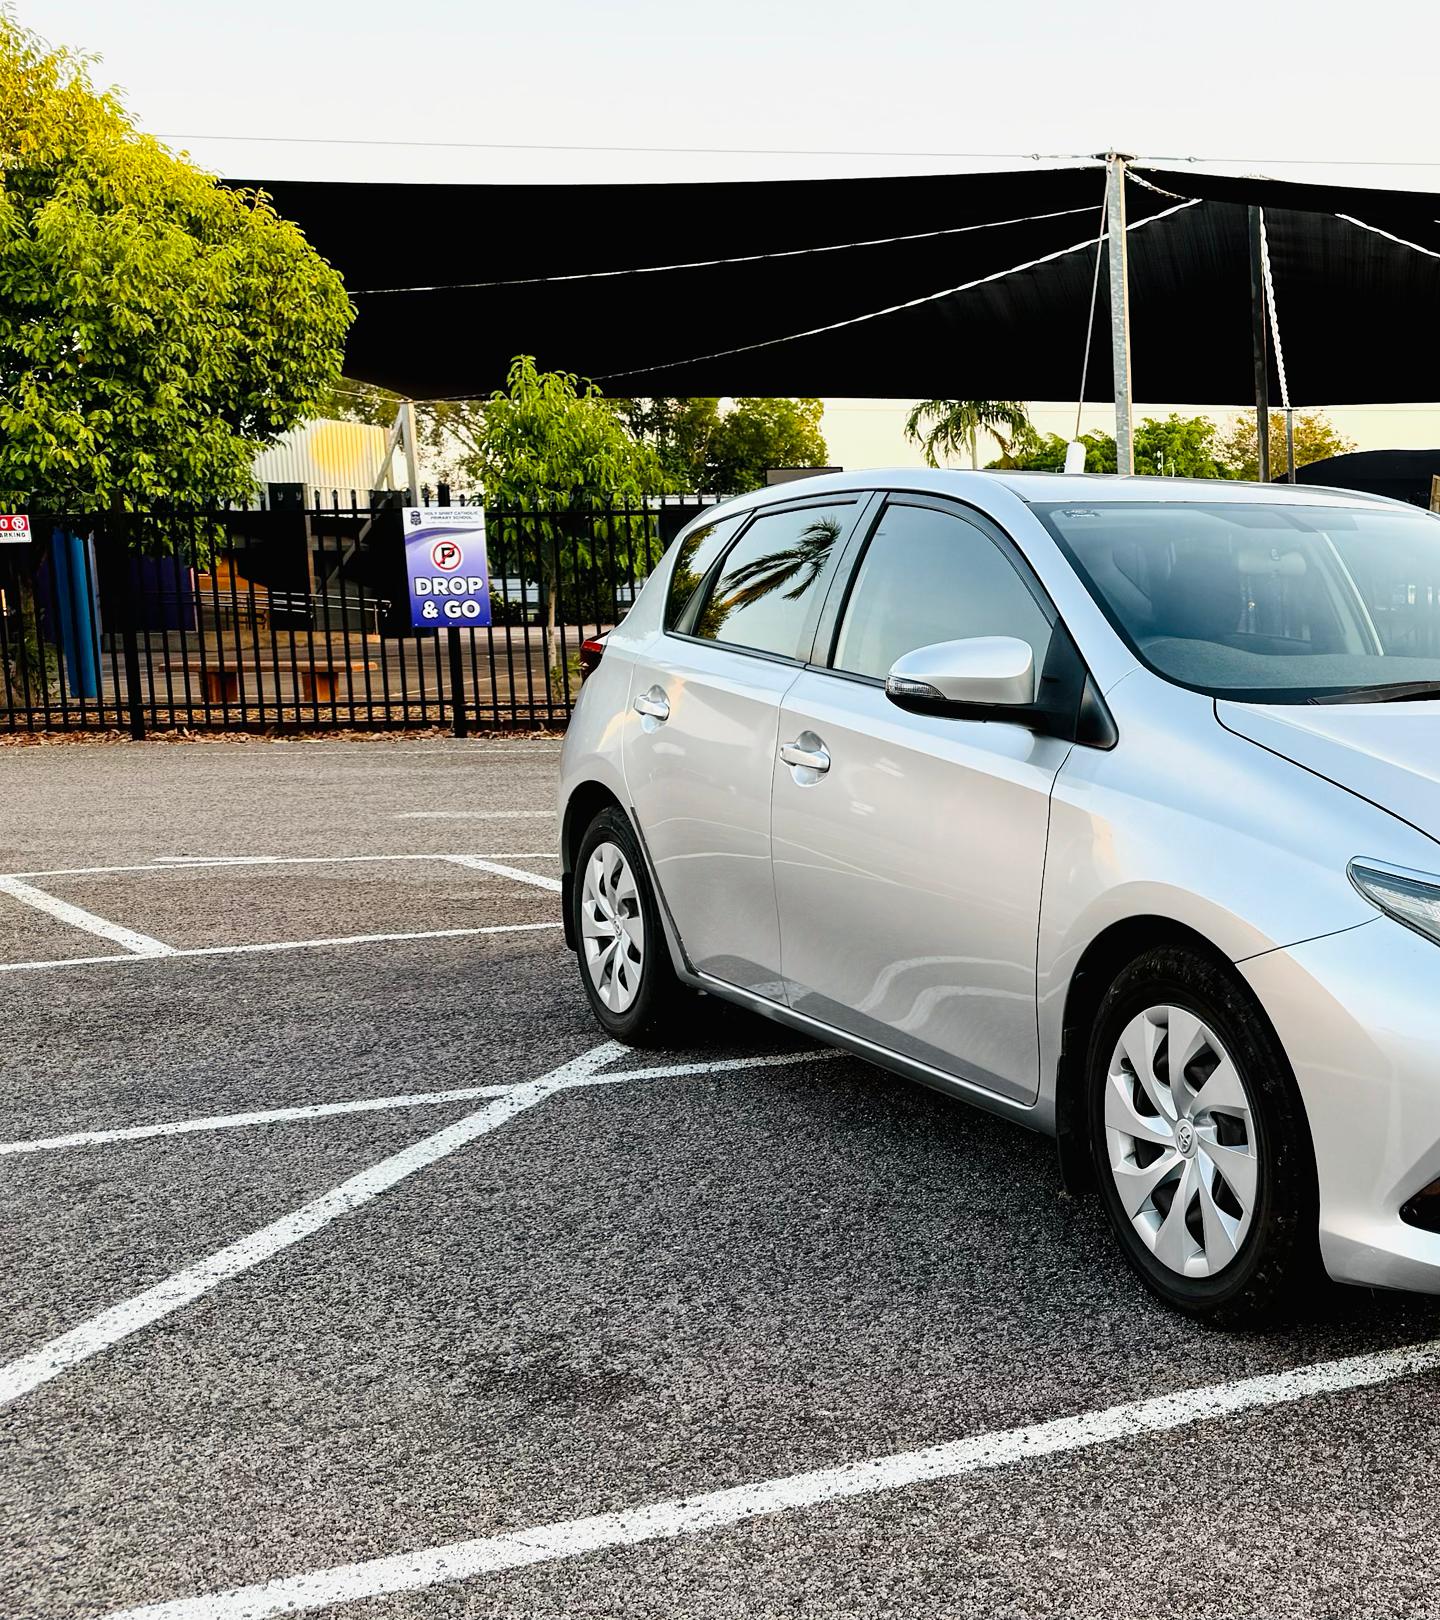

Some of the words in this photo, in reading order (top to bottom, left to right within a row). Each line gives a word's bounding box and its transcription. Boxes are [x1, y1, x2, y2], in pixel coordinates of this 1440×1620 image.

[0, 518, 8, 528] O
[414, 576, 483, 596] DROP
[422, 600, 439, 619] &
[443, 599, 481, 619] GO
